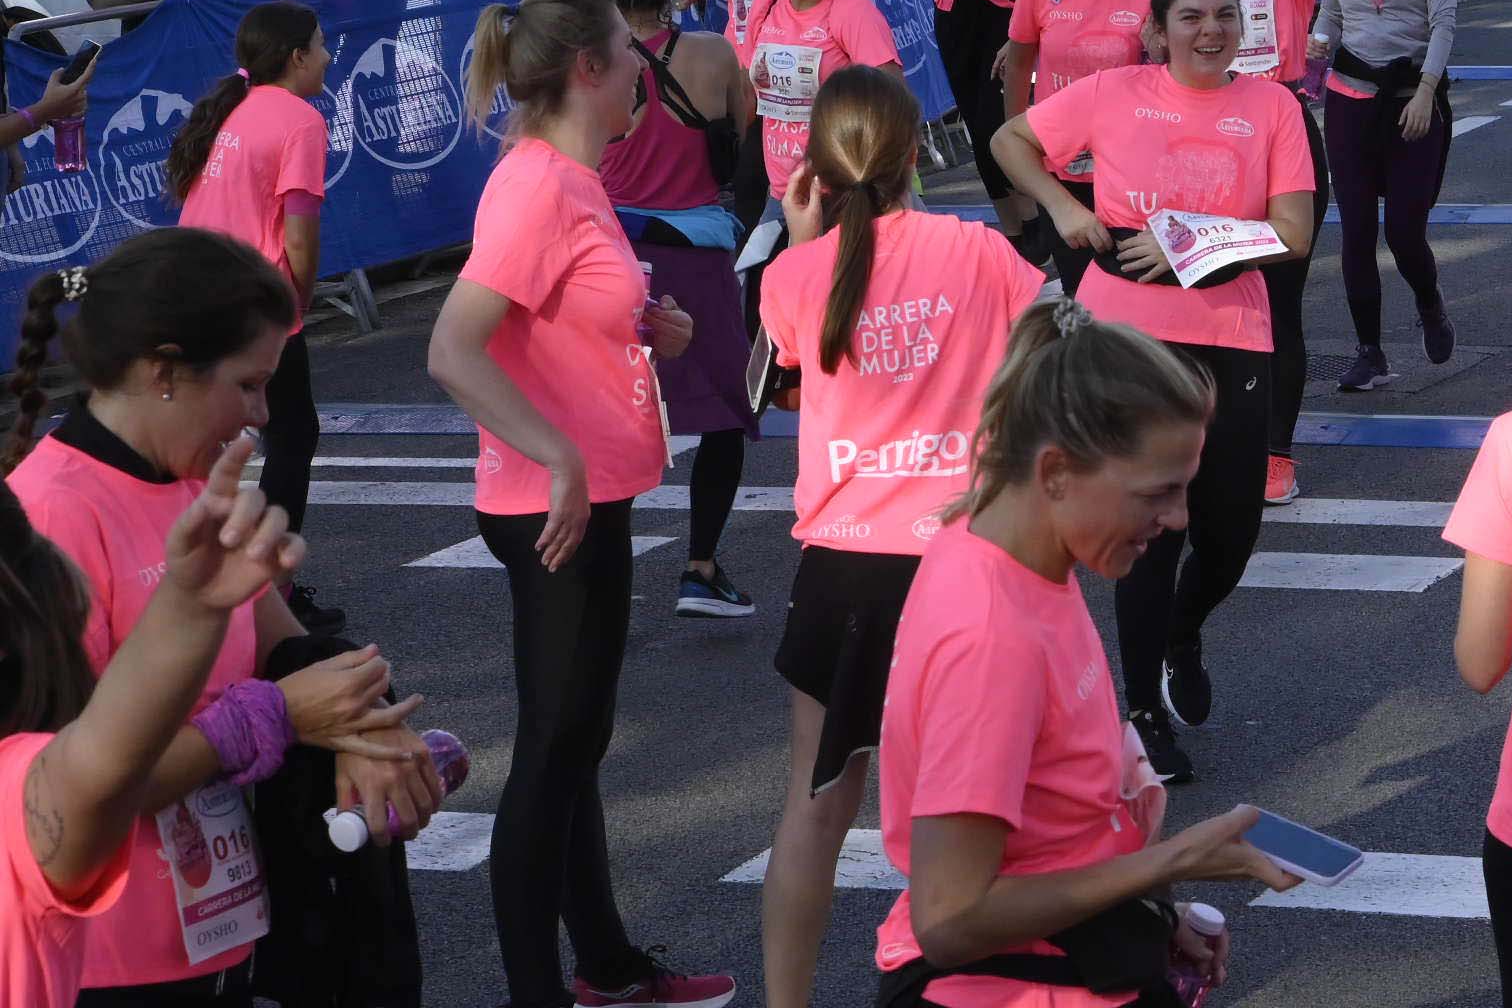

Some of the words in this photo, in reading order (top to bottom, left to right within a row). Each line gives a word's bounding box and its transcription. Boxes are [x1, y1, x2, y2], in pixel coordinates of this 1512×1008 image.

[1049, 10, 1084, 22] OYSHO
[771, 74, 792, 87] 016
[1135, 107, 1182, 124] OYSHO
[767, 135, 804, 157] SUMA
[1126, 191, 1158, 215] TU
[1197, 223, 1235, 238] 016
[1209, 235, 1233, 244] 6321
[1185, 246, 1214, 266] CARRERA
[855, 293, 953, 330] ARRERA
[862, 329, 895, 354] DE
[903, 323, 934, 347] LA
[858, 344, 941, 377] MUJER
[828, 430, 968, 483] Perrigo
[211, 825, 251, 862] 016
[225, 859, 253, 884] 9813
[196, 918, 240, 948] OYSHO
